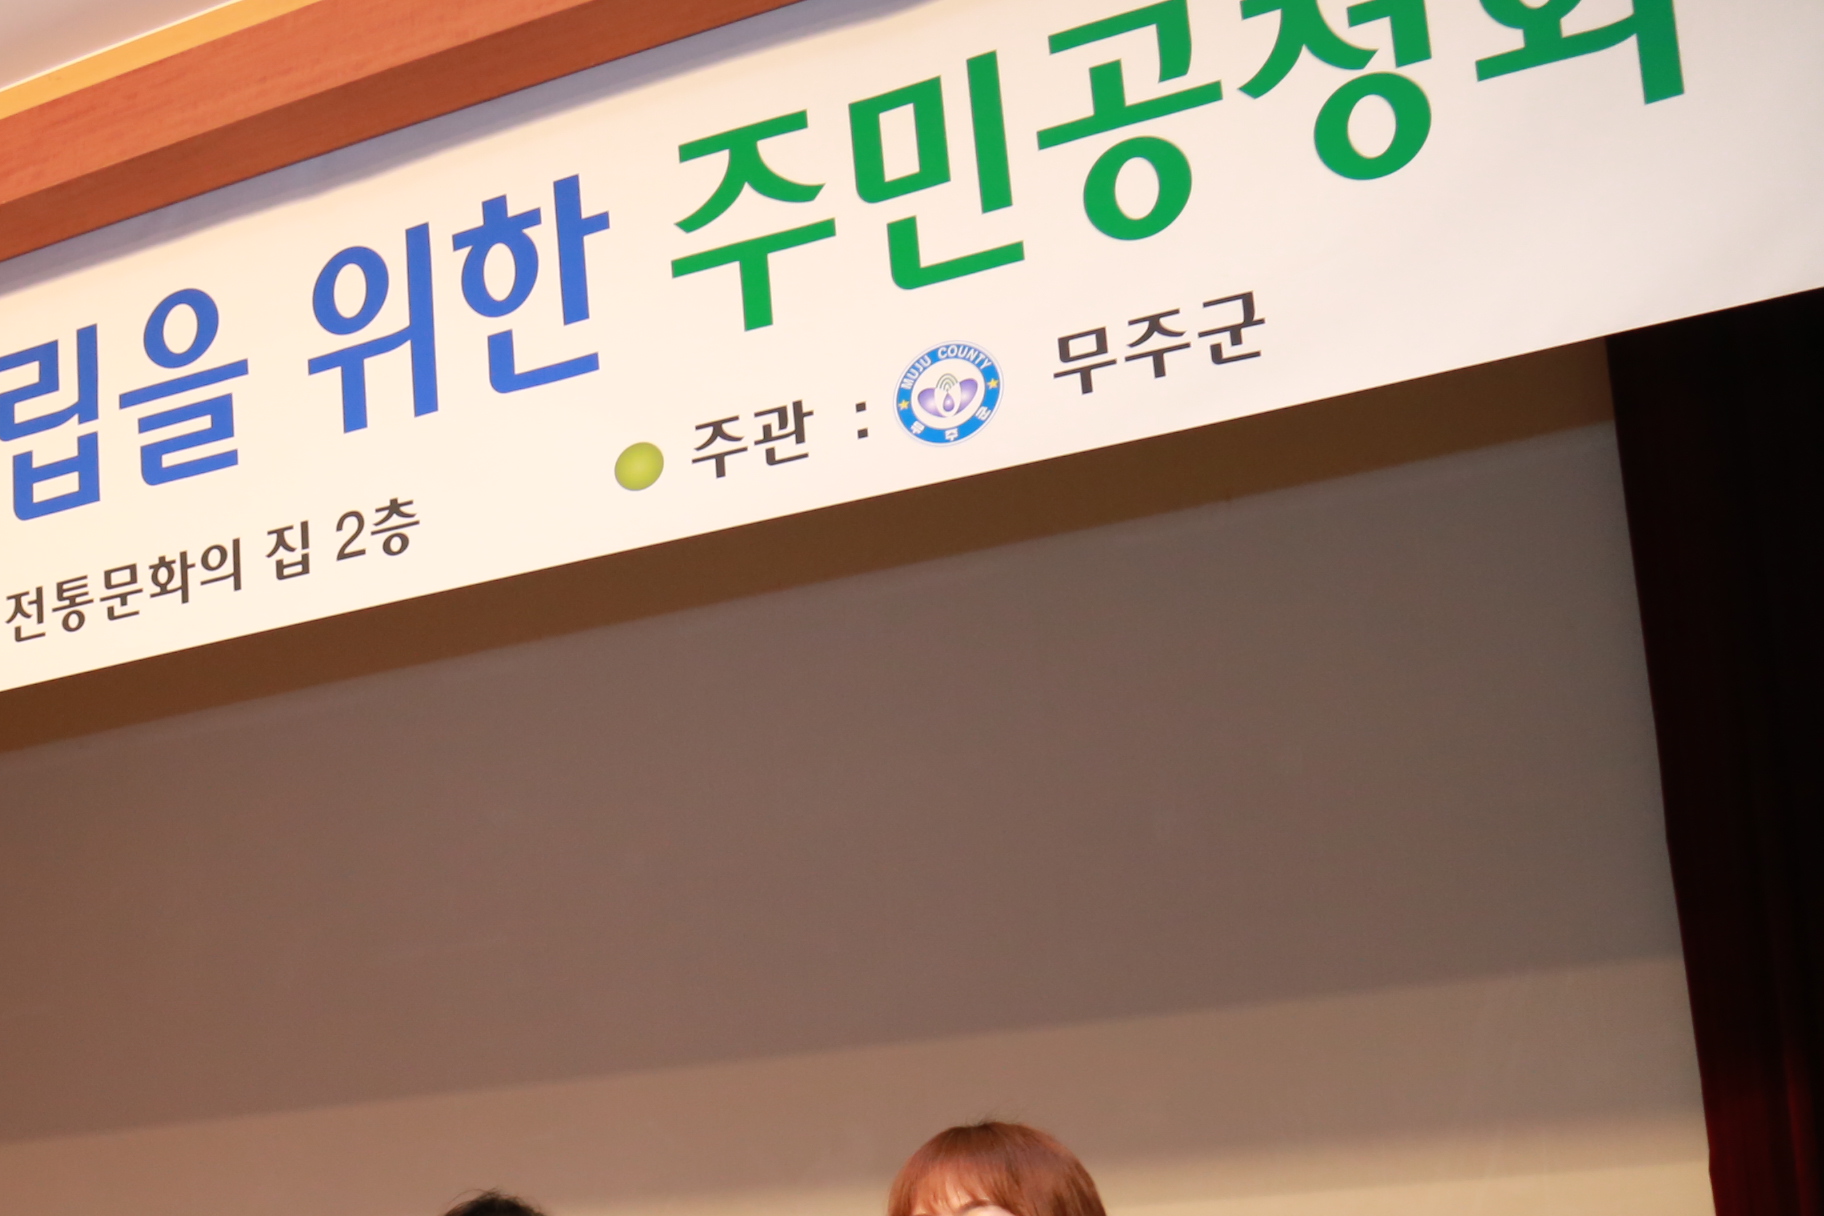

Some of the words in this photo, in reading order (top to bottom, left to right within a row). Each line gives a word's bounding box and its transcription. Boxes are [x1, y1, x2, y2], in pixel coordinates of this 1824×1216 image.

[308, 174, 610, 433] 위한
[692, 400, 814, 478] 주관
[1053, 291, 1265, 395] 무주군
[900, 354, 932, 390] MUJU
[937, 344, 992, 370] COUNTY
[6, 538, 241, 642] 전통문화의
[266, 520, 310, 580] 집
[336, 498, 420, 561] 2층
